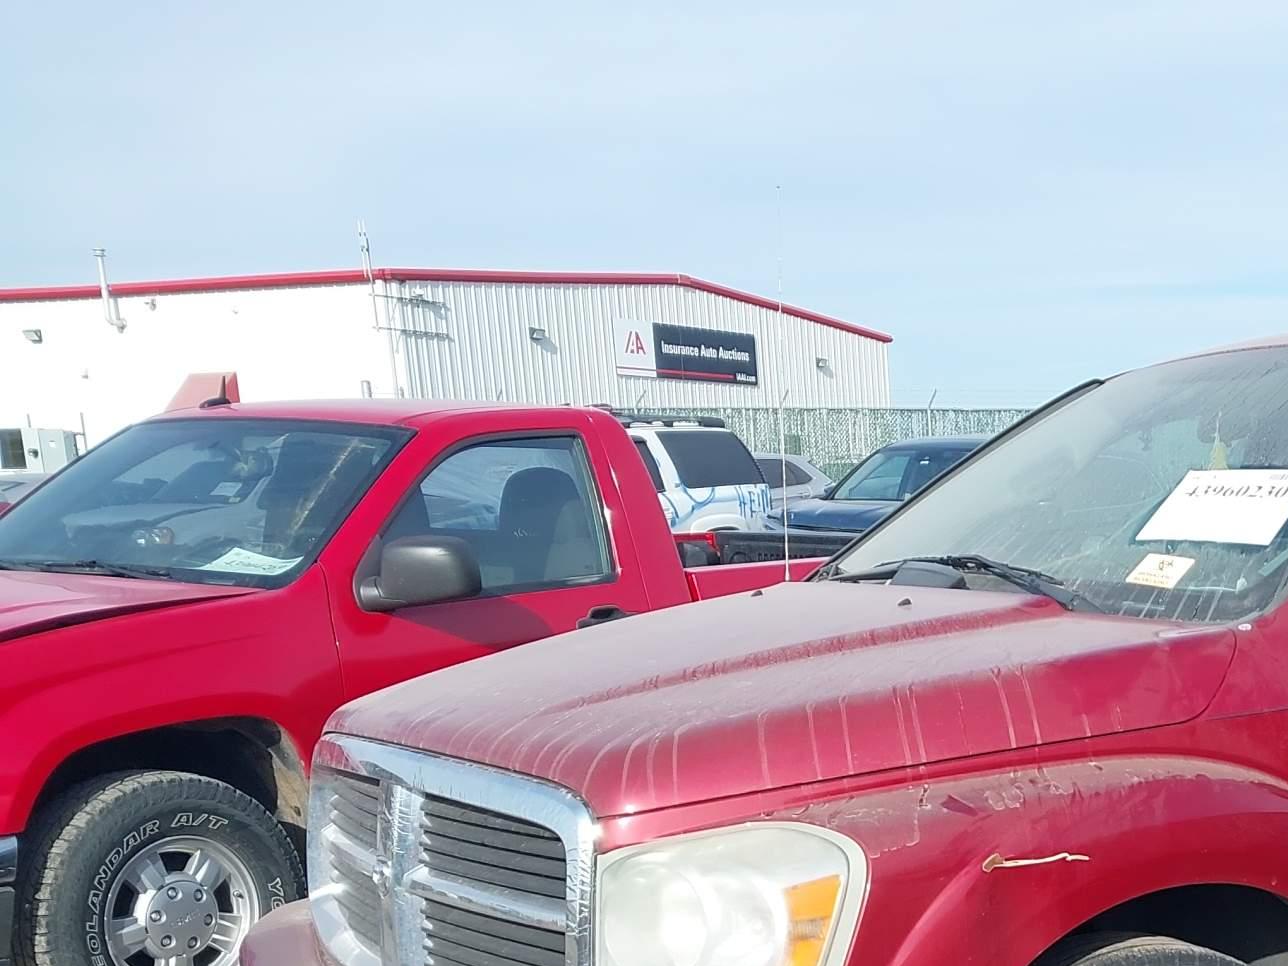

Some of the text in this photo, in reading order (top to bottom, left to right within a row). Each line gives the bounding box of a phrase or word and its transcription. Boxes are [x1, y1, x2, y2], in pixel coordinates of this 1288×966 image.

[661, 340, 750, 362] Insurance Auto Auctions
[170, 812, 230, 830] A/T
